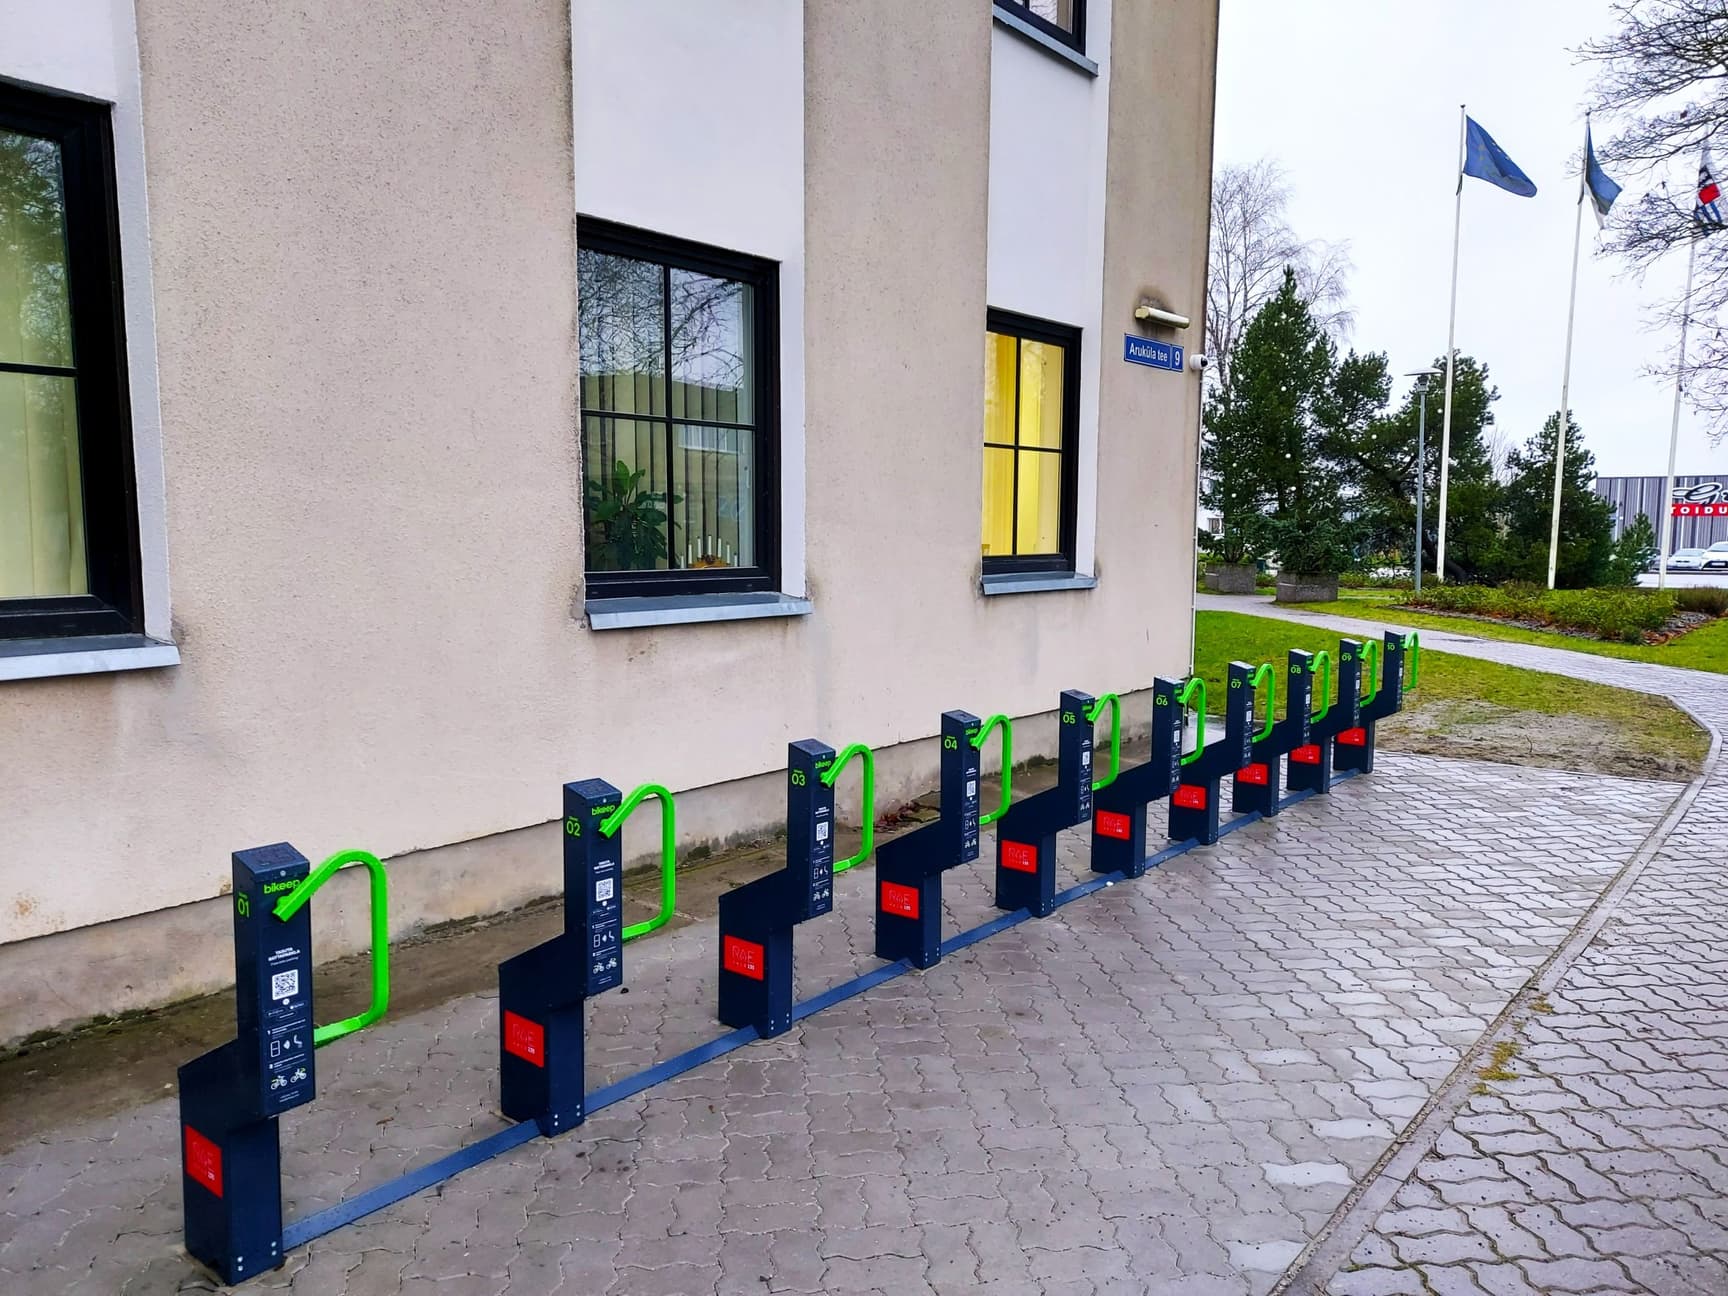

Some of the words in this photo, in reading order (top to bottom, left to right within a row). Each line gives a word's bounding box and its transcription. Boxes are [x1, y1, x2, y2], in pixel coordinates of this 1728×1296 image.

[1129, 343, 1157, 359] Aruküla
[1158, 349, 1168, 361] tee
[1174, 351, 1181, 366] 9
[1290, 665, 1302, 674] 08
[1230, 680, 1242, 689] 07
[1156, 696, 1168, 706] 06
[1063, 713, 1076, 724] 05
[944, 738, 958, 750] 04
[791, 772, 806, 787] 03
[566, 820, 581, 837] 02
[237, 898, 250, 918] 01
